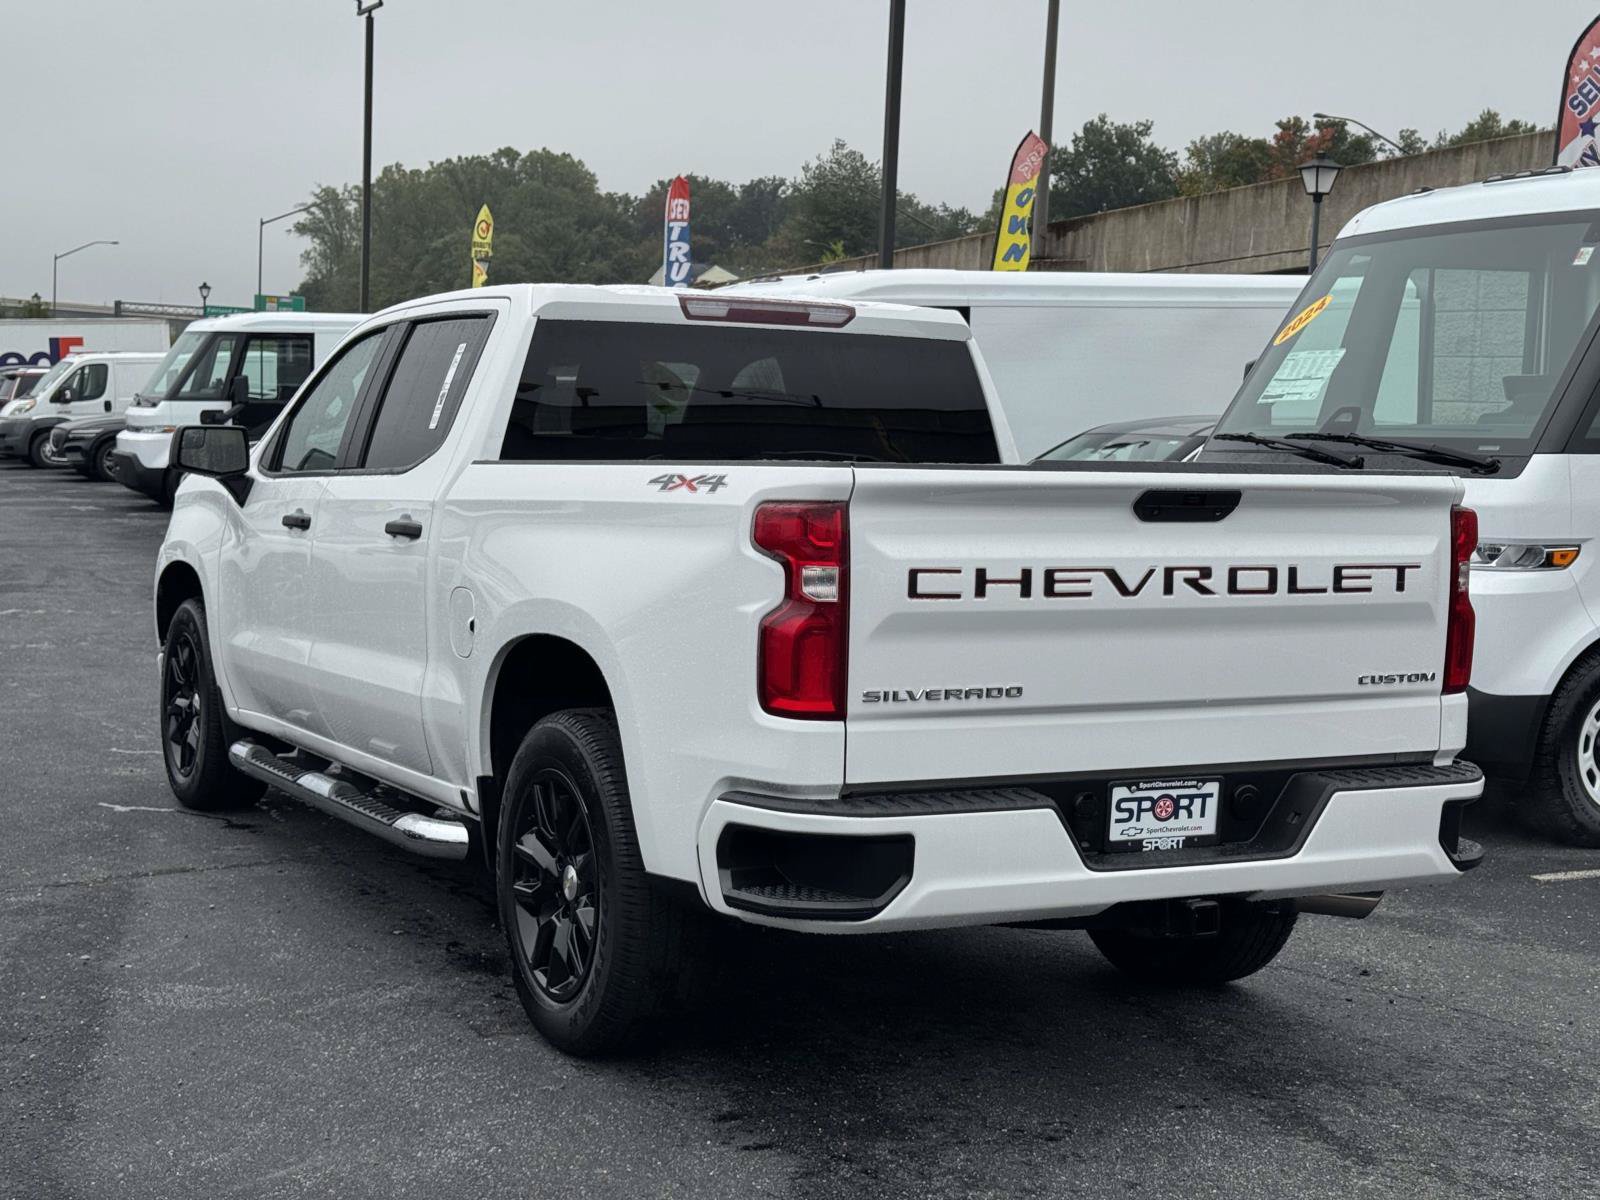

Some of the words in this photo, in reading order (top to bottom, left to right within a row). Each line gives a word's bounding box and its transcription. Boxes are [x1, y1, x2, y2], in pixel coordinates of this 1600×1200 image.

[1568, 64, 1600, 118] SEL
[1002, 187, 1034, 271] OWN
[1279, 298, 1328, 342] 2024
[907, 563, 1421, 601] CHEVROLET
[1357, 672, 1436, 686] CUSTOM
[861, 685, 1024, 703] SILVERADO
[1138, 780, 1197, 790] SportChevrolet.com
[1114, 793, 1214, 824] SPORT
[1146, 825, 1203, 835] SportChevrolet.com
[1142, 836, 1186, 852] SPORT
